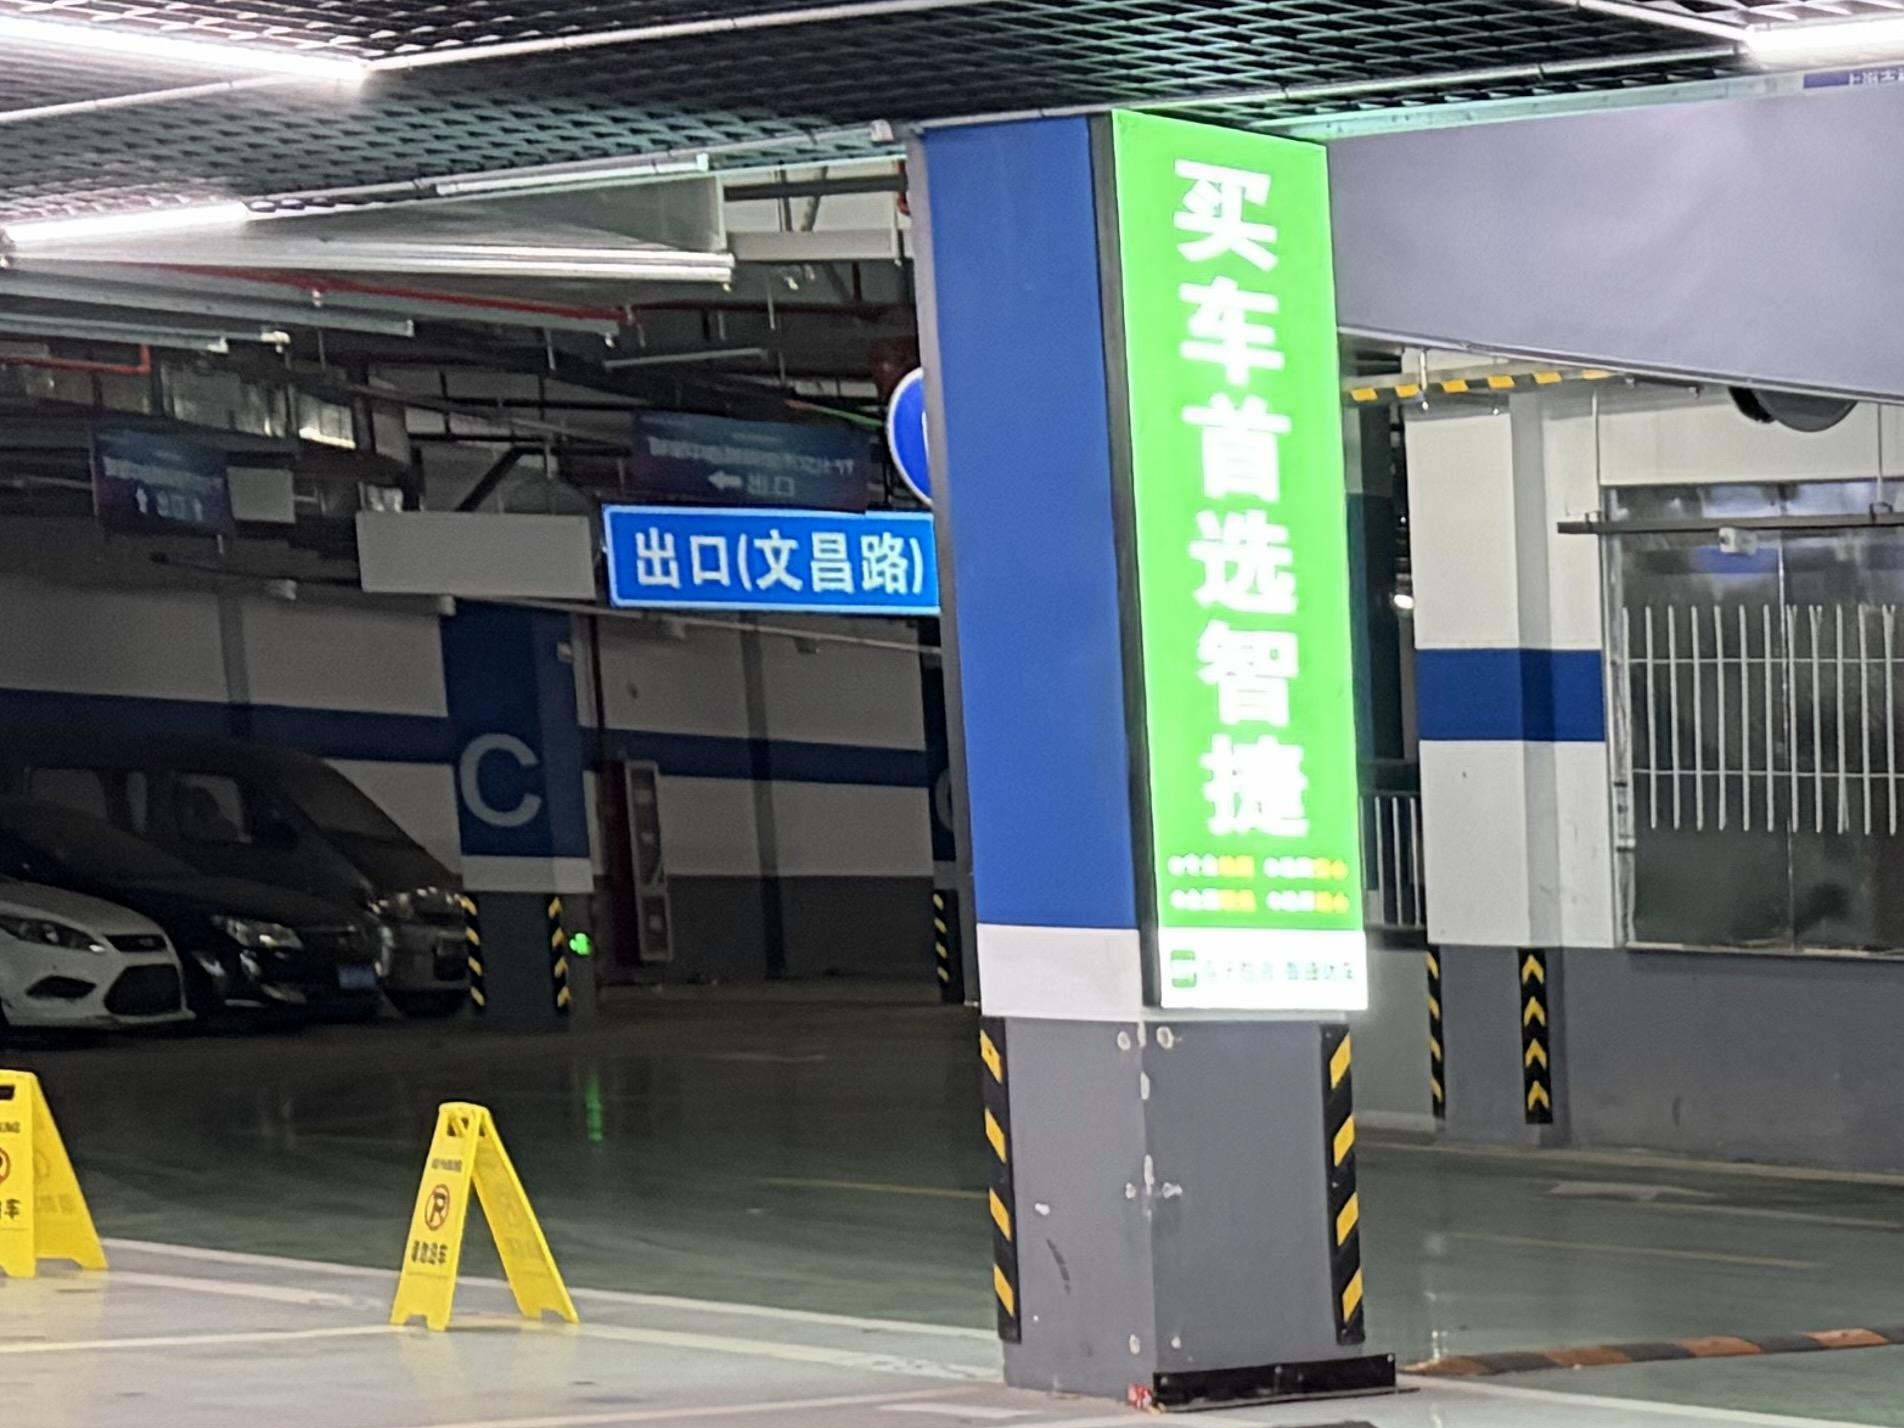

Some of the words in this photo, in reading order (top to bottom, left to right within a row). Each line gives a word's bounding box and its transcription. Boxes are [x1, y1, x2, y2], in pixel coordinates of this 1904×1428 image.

[1172, 158, 1309, 837] 买车首选智捷
[635, 526, 923, 594] 出口(文昌路)
[459, 732, 542, 828] C
